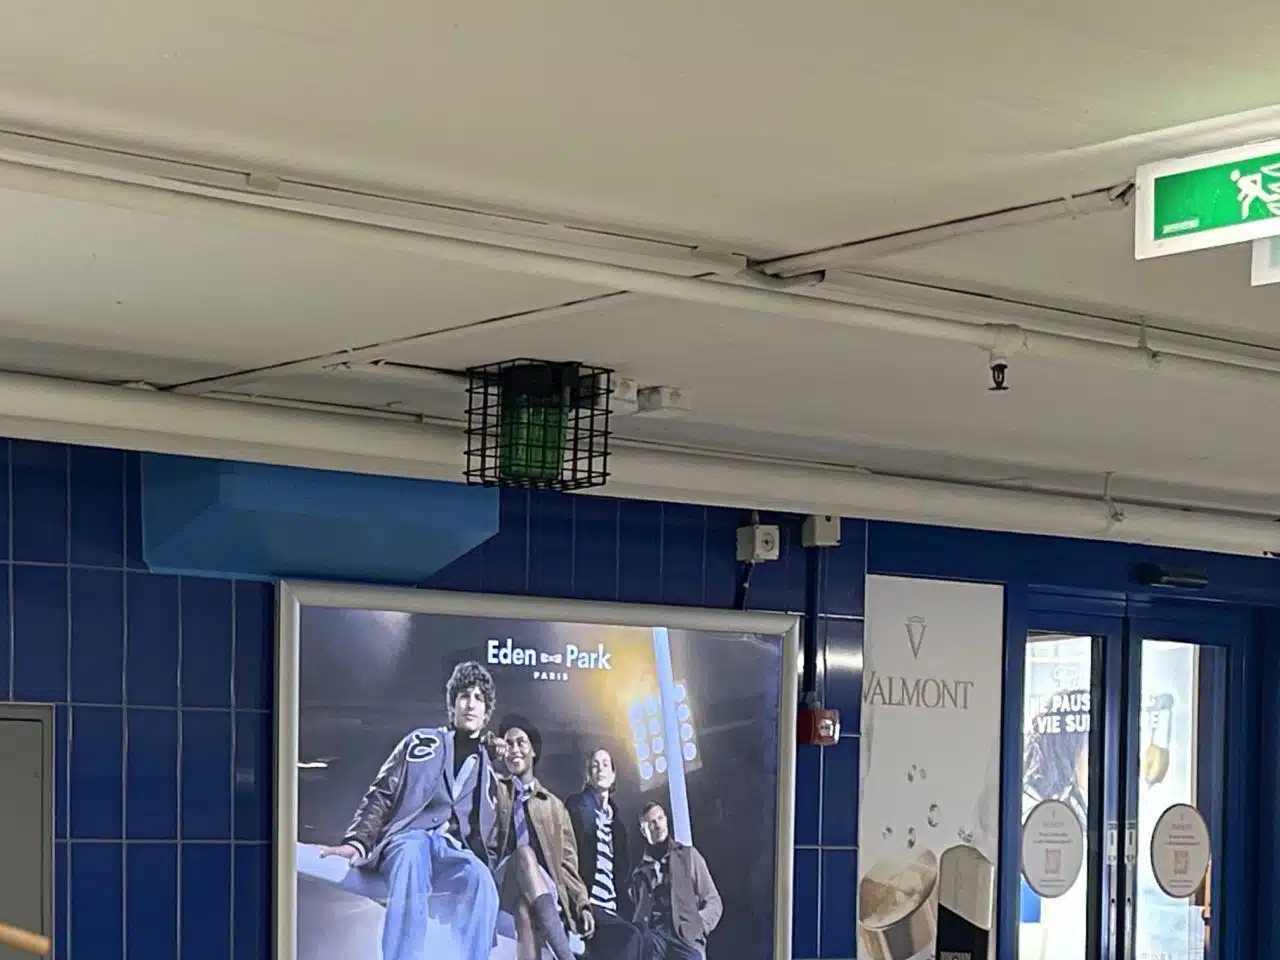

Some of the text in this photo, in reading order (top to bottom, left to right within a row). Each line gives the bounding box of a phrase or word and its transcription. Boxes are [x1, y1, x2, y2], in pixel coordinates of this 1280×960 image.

[487, 638, 612, 670] Eden Park
[533, 671, 569, 681] PARIS
[1052, 692, 1090, 713] PAUS
[1036, 715, 1062, 734] VIE
